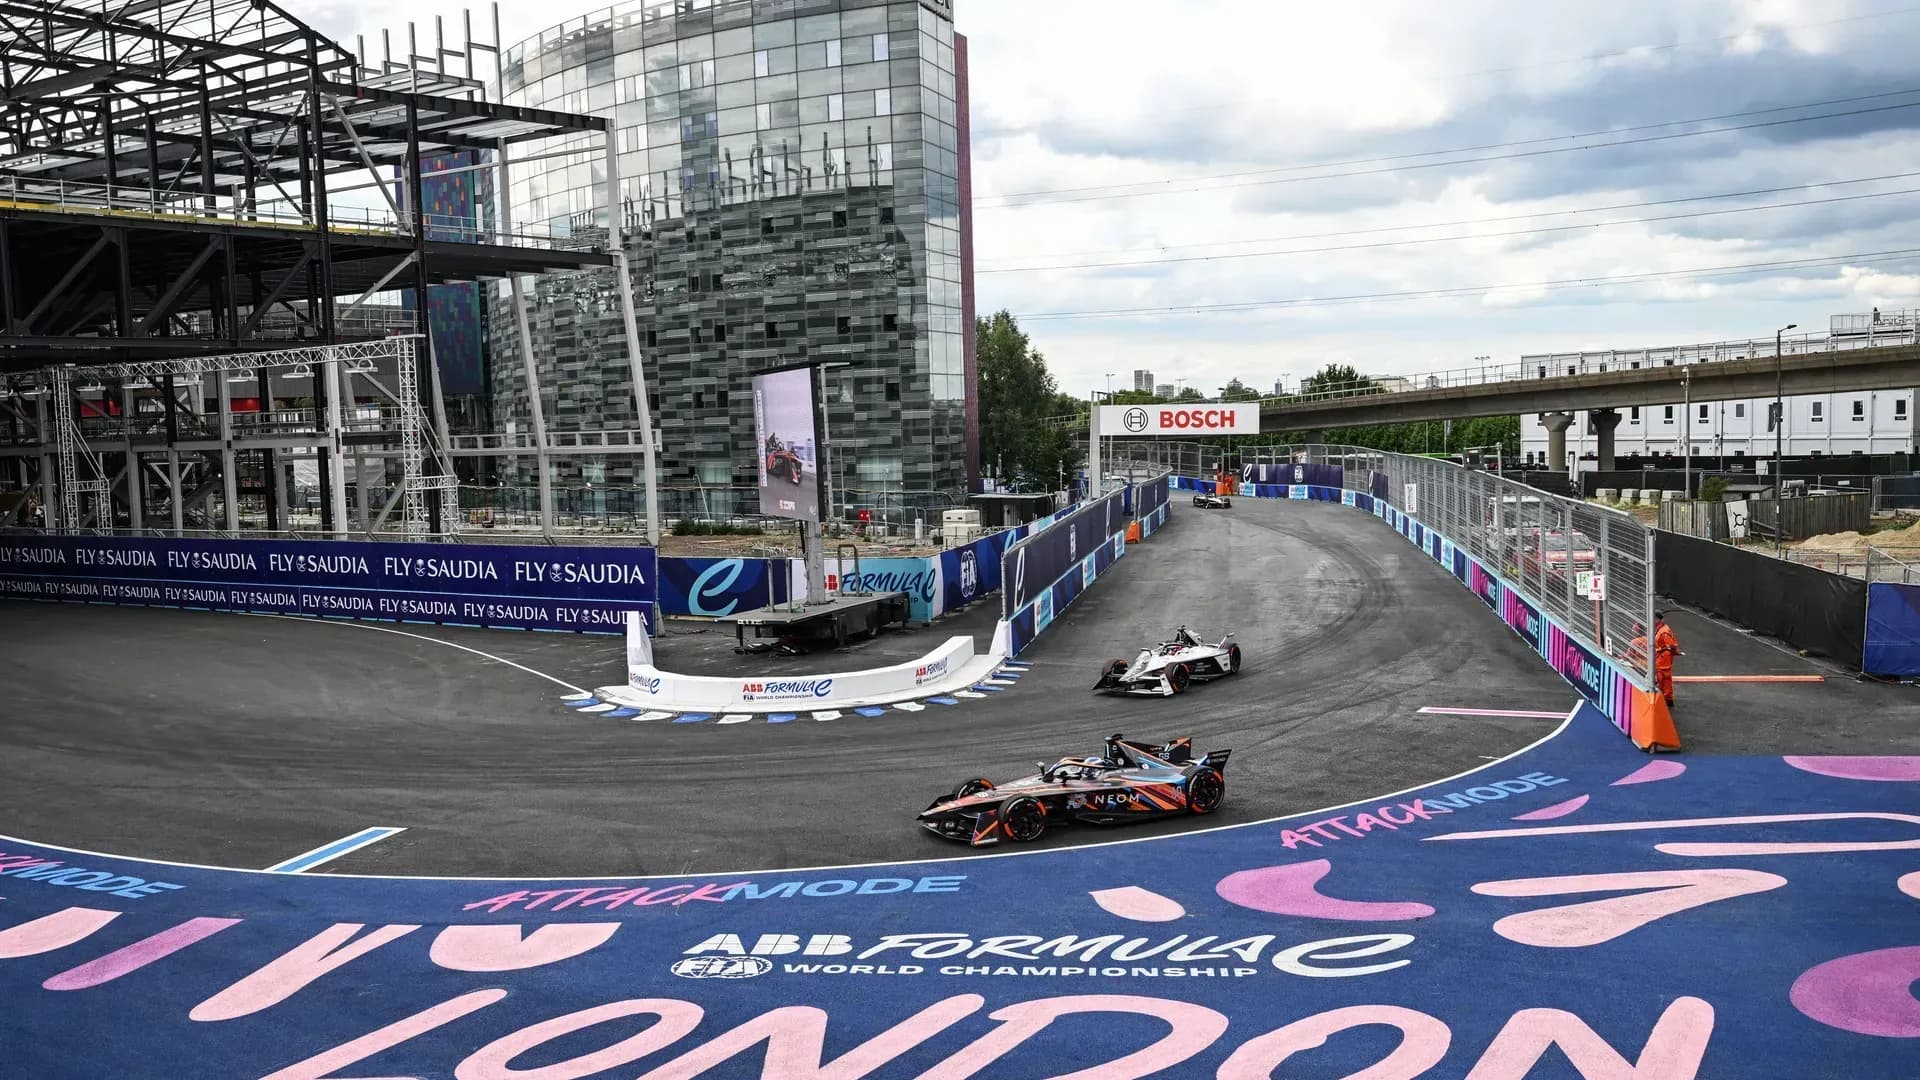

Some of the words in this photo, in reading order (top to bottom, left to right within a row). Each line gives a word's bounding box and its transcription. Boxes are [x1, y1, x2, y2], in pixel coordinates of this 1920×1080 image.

[1159, 410, 1235, 428] BOSCH
[0, 547, 12, 562] LY
[22, 547, 66, 564] SAUDIA
[76, 549, 97, 565] FLY
[106, 549, 157, 567] SAUDIA
[168, 551, 191, 568] FLY
[201, 552, 257, 570] SAUDIA
[269, 554, 294, 572] FLY
[307, 555, 370, 574] SAUDIA
[384, 557, 412, 576] FLY
[427, 558, 498, 579] SAUDIA
[515, 561, 547, 582] FLY
[564, 563, 645, 584] SAUDIA
[842, 571, 924, 592] FORMULA
[46, 582, 59, 593] FLY
[66, 583, 98, 595] SAUDIA
[103, 584, 118, 596] FLY
[125, 585, 160, 599] SAUDIA
[165, 587, 182, 600] FLY
[188, 588, 226, 602] SAUDIA
[231, 591, 248, 604] FLY
[256, 592, 296, 606] SAUDIA
[303, 594, 321, 608] FLY
[329, 596, 373, 611] SAUDIA
[379, 599, 400, 612] FLY
[409, 600, 456, 616] SAUDIA
[464, 603, 486, 617] FLY
[496, 604, 548, 621] SAUDIA
[556, 608, 580, 622] FLY
[742, 684, 764, 693] ABB
[764, 681, 816, 694] FORMULA
[1095, 794, 1140, 804] NEOM
[682, 933, 854, 956] ABB
[856, 933, 1276, 962] FORMULA
[783, 963, 925, 975] WORLD
[939, 964, 1259, 977] CHAMPIONSHIP
[256, 988, 1714, 1080] LONDON
